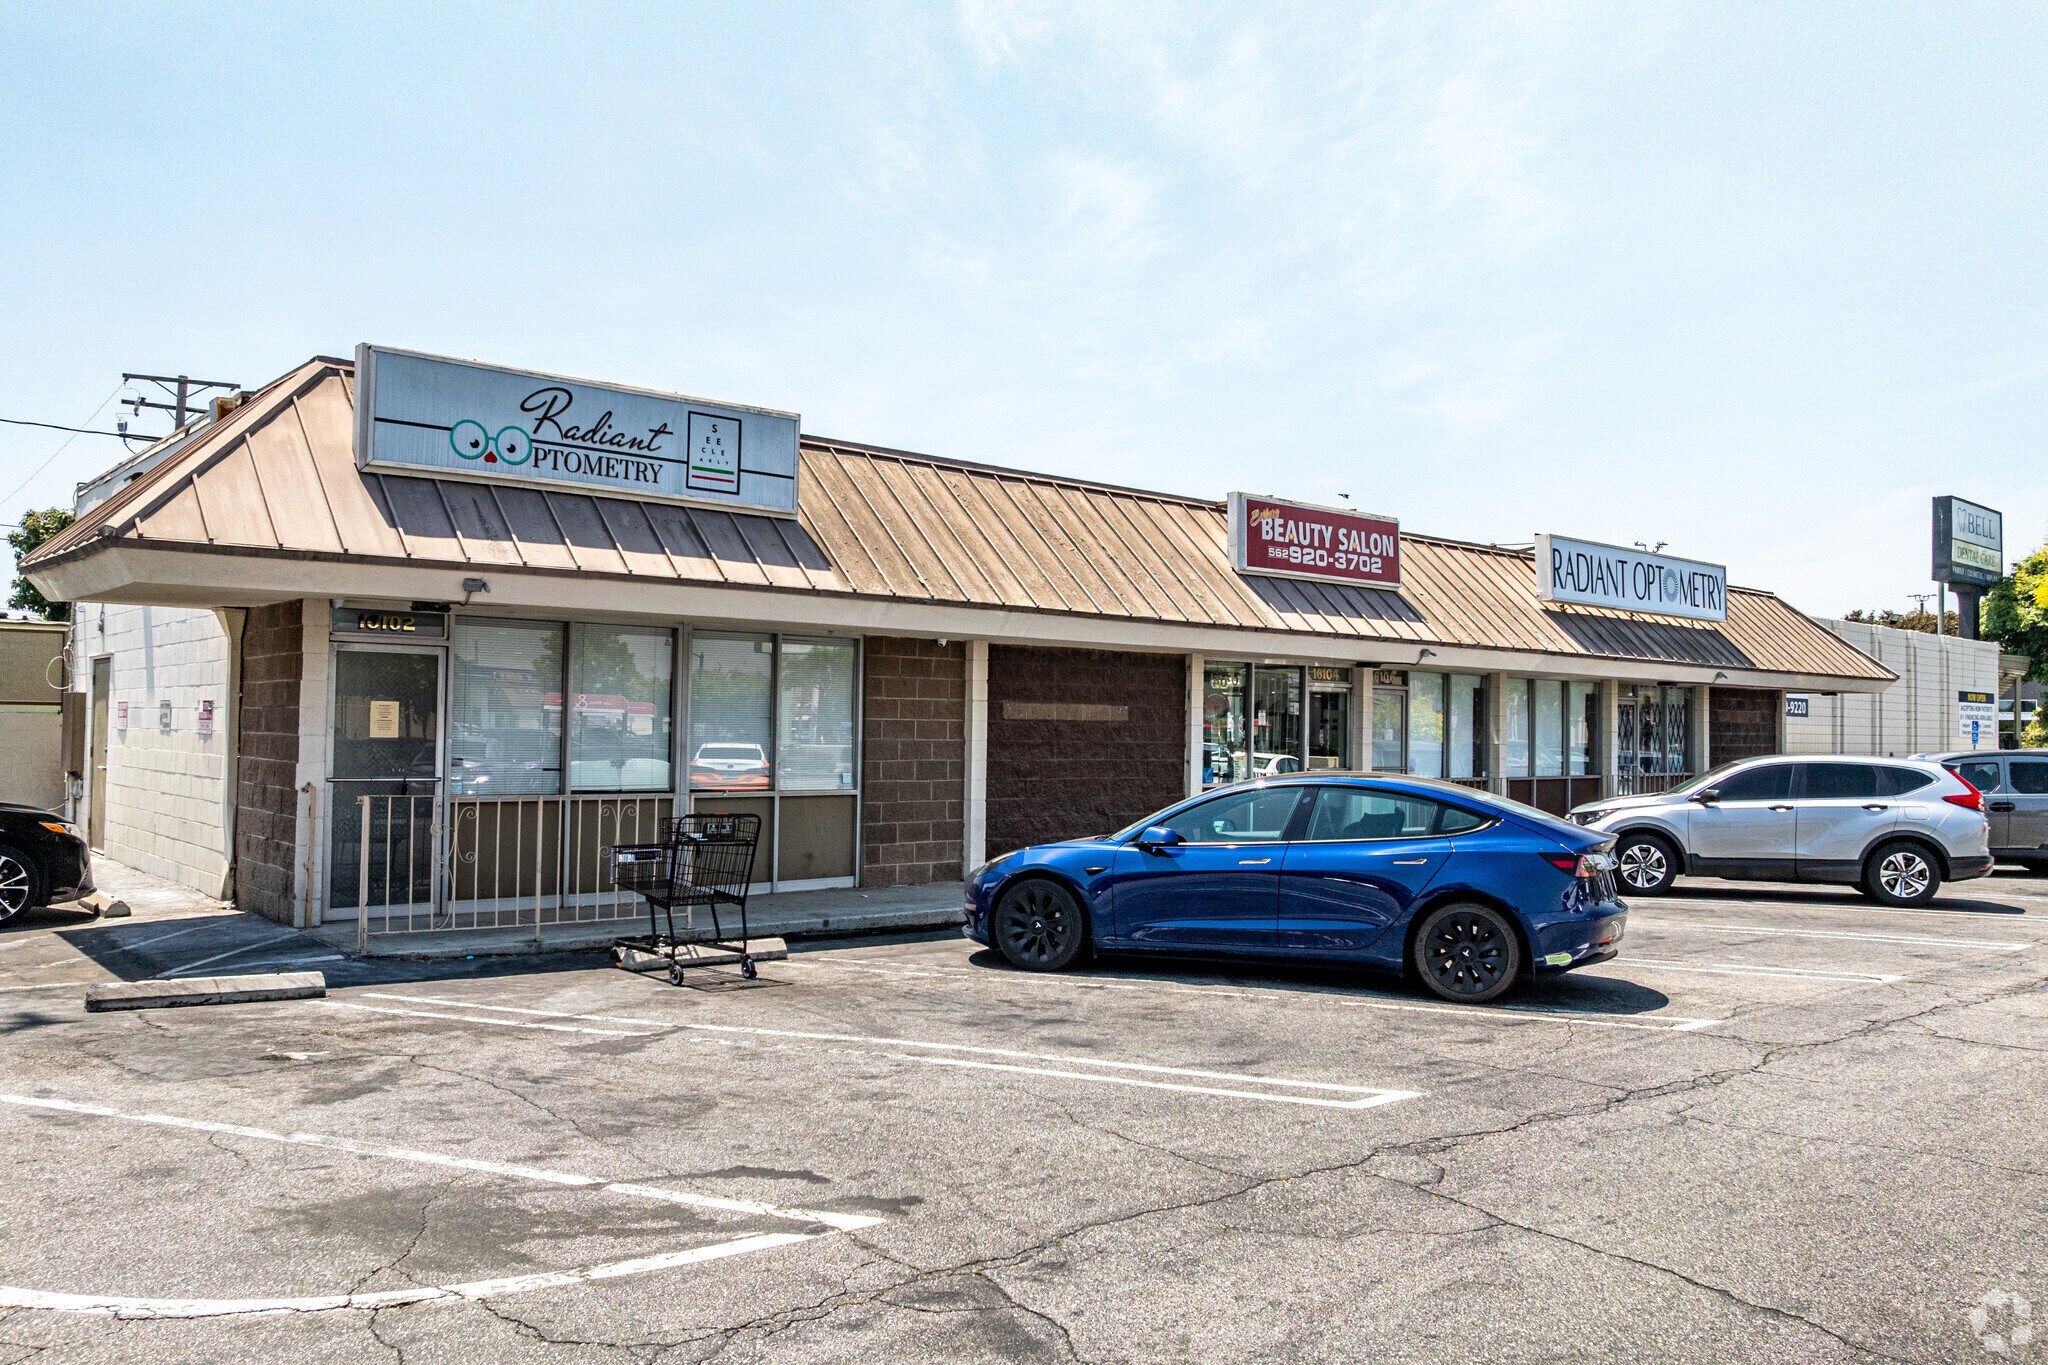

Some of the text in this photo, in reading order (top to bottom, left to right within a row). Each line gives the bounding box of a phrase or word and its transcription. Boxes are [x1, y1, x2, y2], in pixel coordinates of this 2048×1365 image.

[520, 387, 673, 452] Radiant
[1261, 518, 1394, 558] BEAUTY SALON
[1967, 513, 1995, 540] BELL
[1288, 546, 1382, 574] 920-3702
[1957, 546, 1996, 567] DENTAL CARE
[1552, 548, 1724, 611] RADIANT OPTOMETRY
[1312, 667, 1340, 681] 16104
